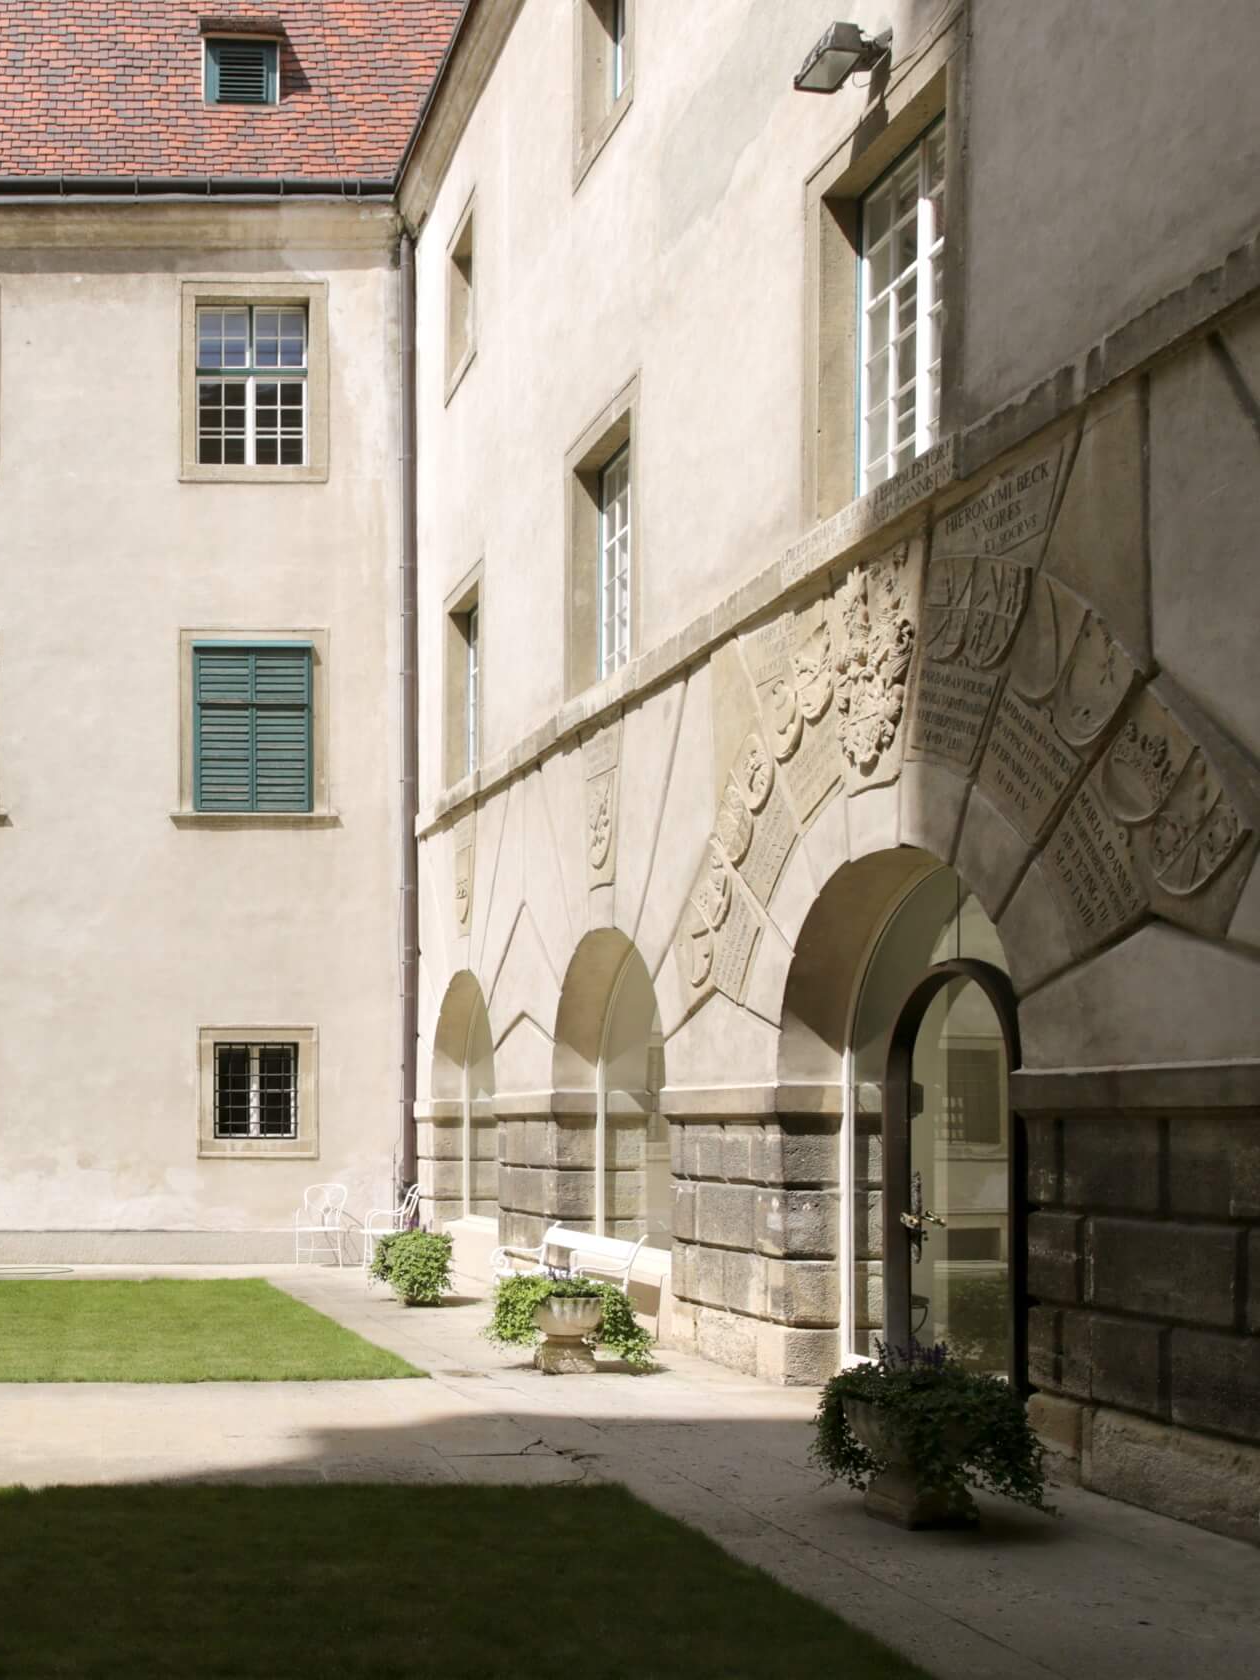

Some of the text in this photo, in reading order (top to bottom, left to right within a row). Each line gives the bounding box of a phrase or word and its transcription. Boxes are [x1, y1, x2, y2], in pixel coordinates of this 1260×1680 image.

[945, 481, 1013, 536] HIERONYMI
[1016, 460, 1049, 493] BECK
[1078, 791, 1105, 842] MARIA
